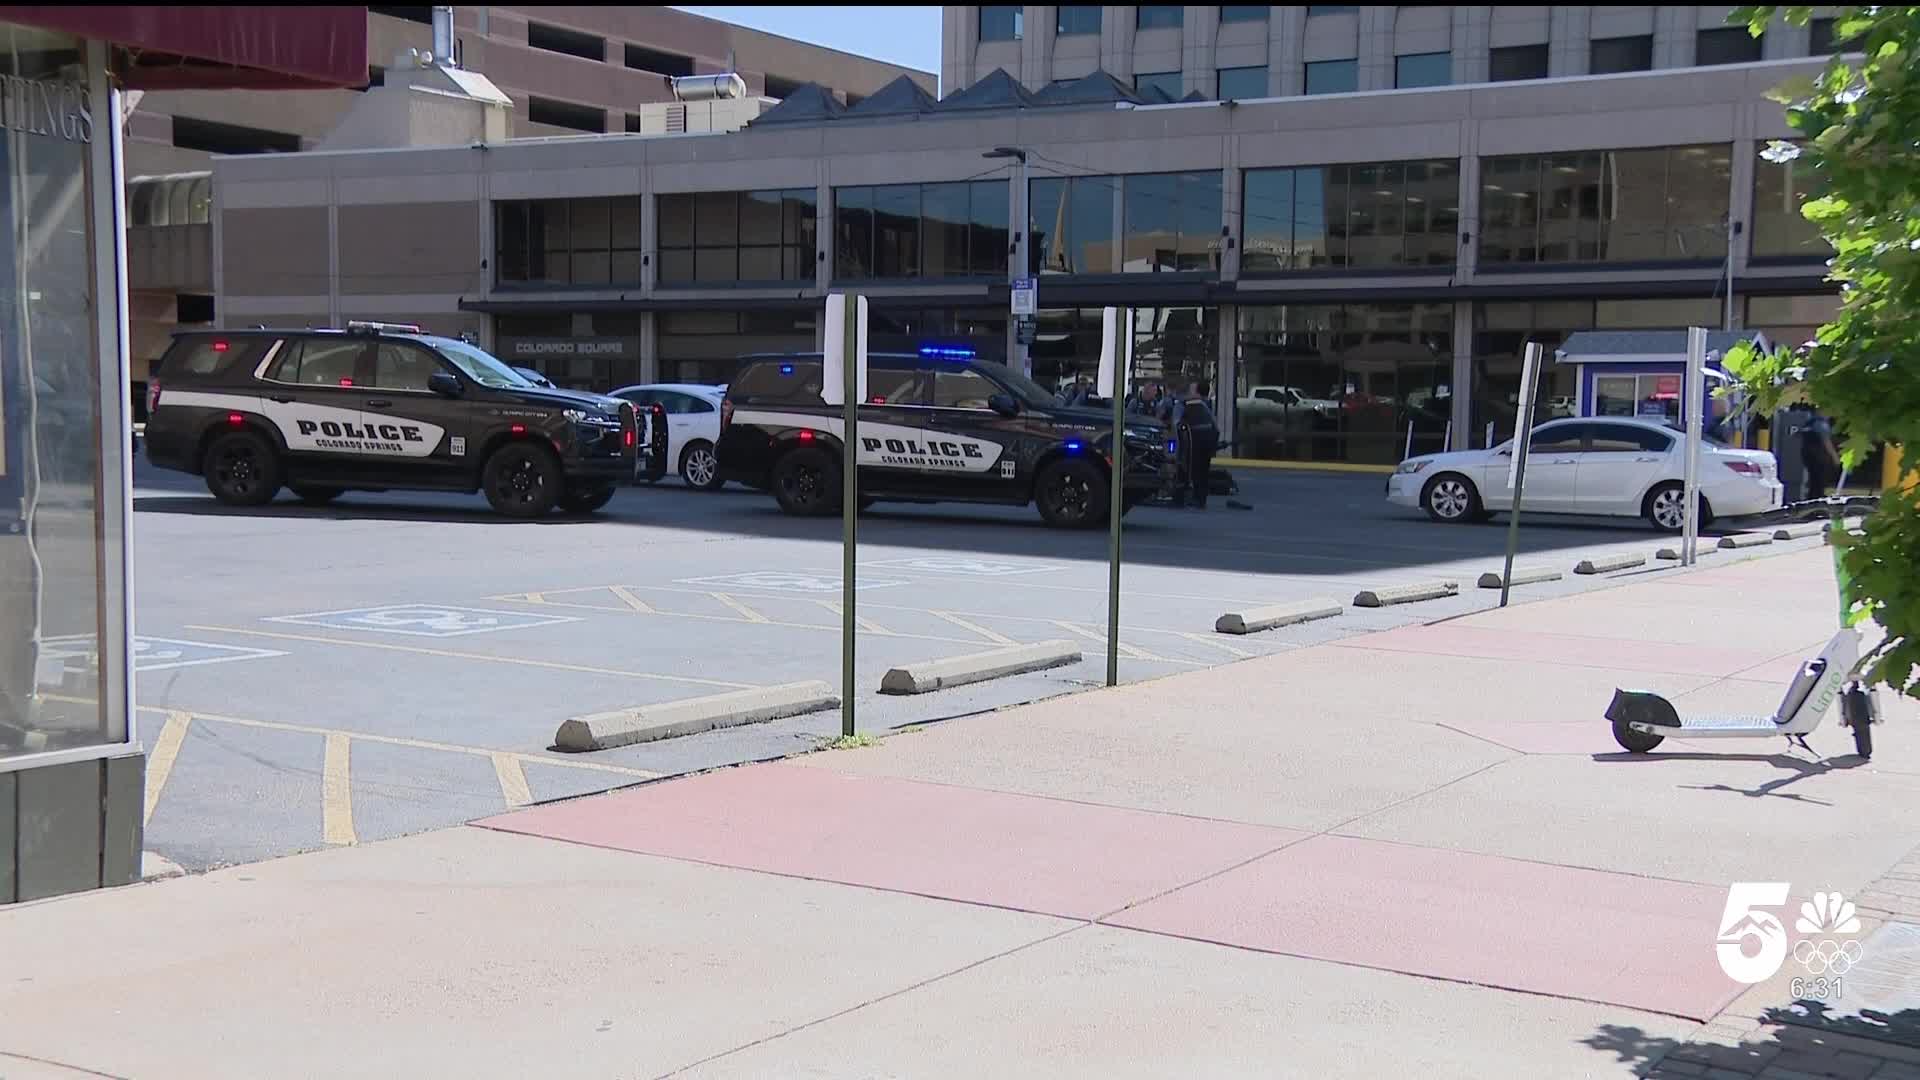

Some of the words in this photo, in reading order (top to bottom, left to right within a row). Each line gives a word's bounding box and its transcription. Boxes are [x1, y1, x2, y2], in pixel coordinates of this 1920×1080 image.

[515, 343, 575, 353] COLORADO
[296, 419, 424, 442] POLICE
[315, 439, 363, 449] COLORADO
[363, 442, 404, 452] SPRINGS
[861, 437, 984, 459] POLICE
[881, 455, 926, 465] COLORADO
[927, 458, 967, 468] SPRINGS
[1810, 671, 1841, 713] Lime
